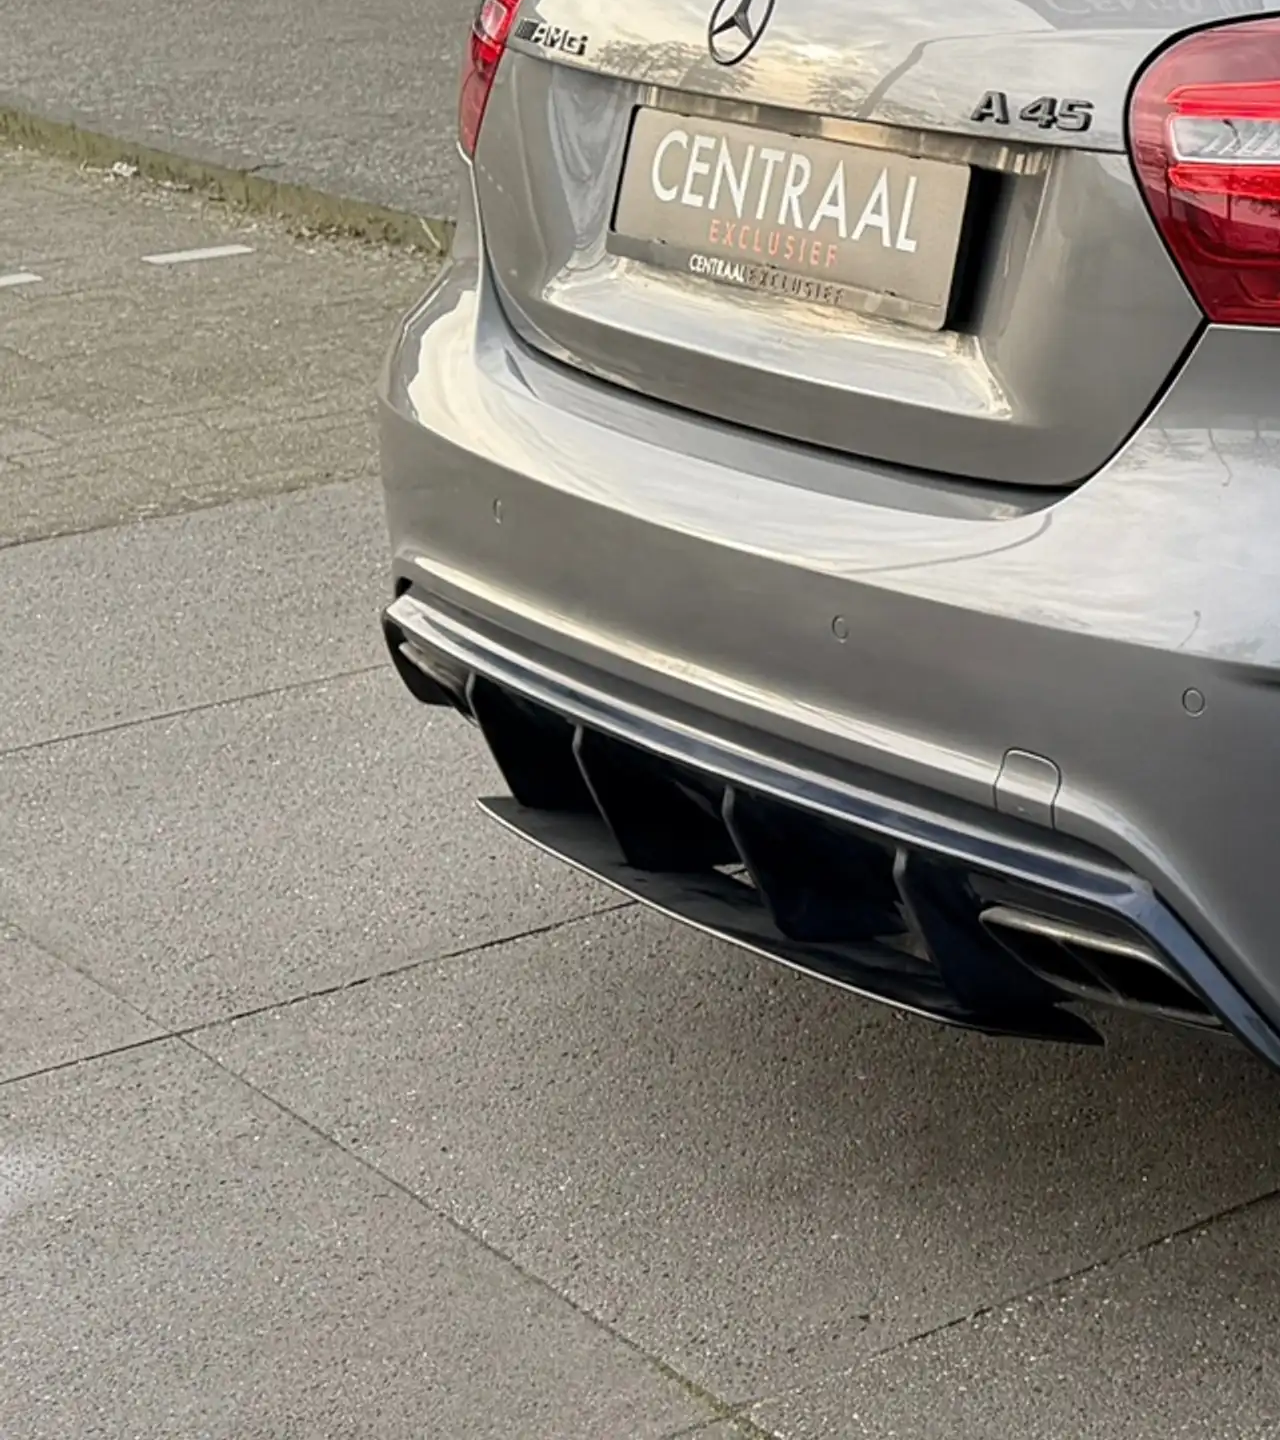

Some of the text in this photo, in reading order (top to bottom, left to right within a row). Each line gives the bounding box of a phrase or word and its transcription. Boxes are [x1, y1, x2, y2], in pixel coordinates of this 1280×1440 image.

[970, 90, 1095, 132] A 45
[651, 129, 918, 253] CENTRAAL
[708, 218, 839, 268] EXCLUSIEF
